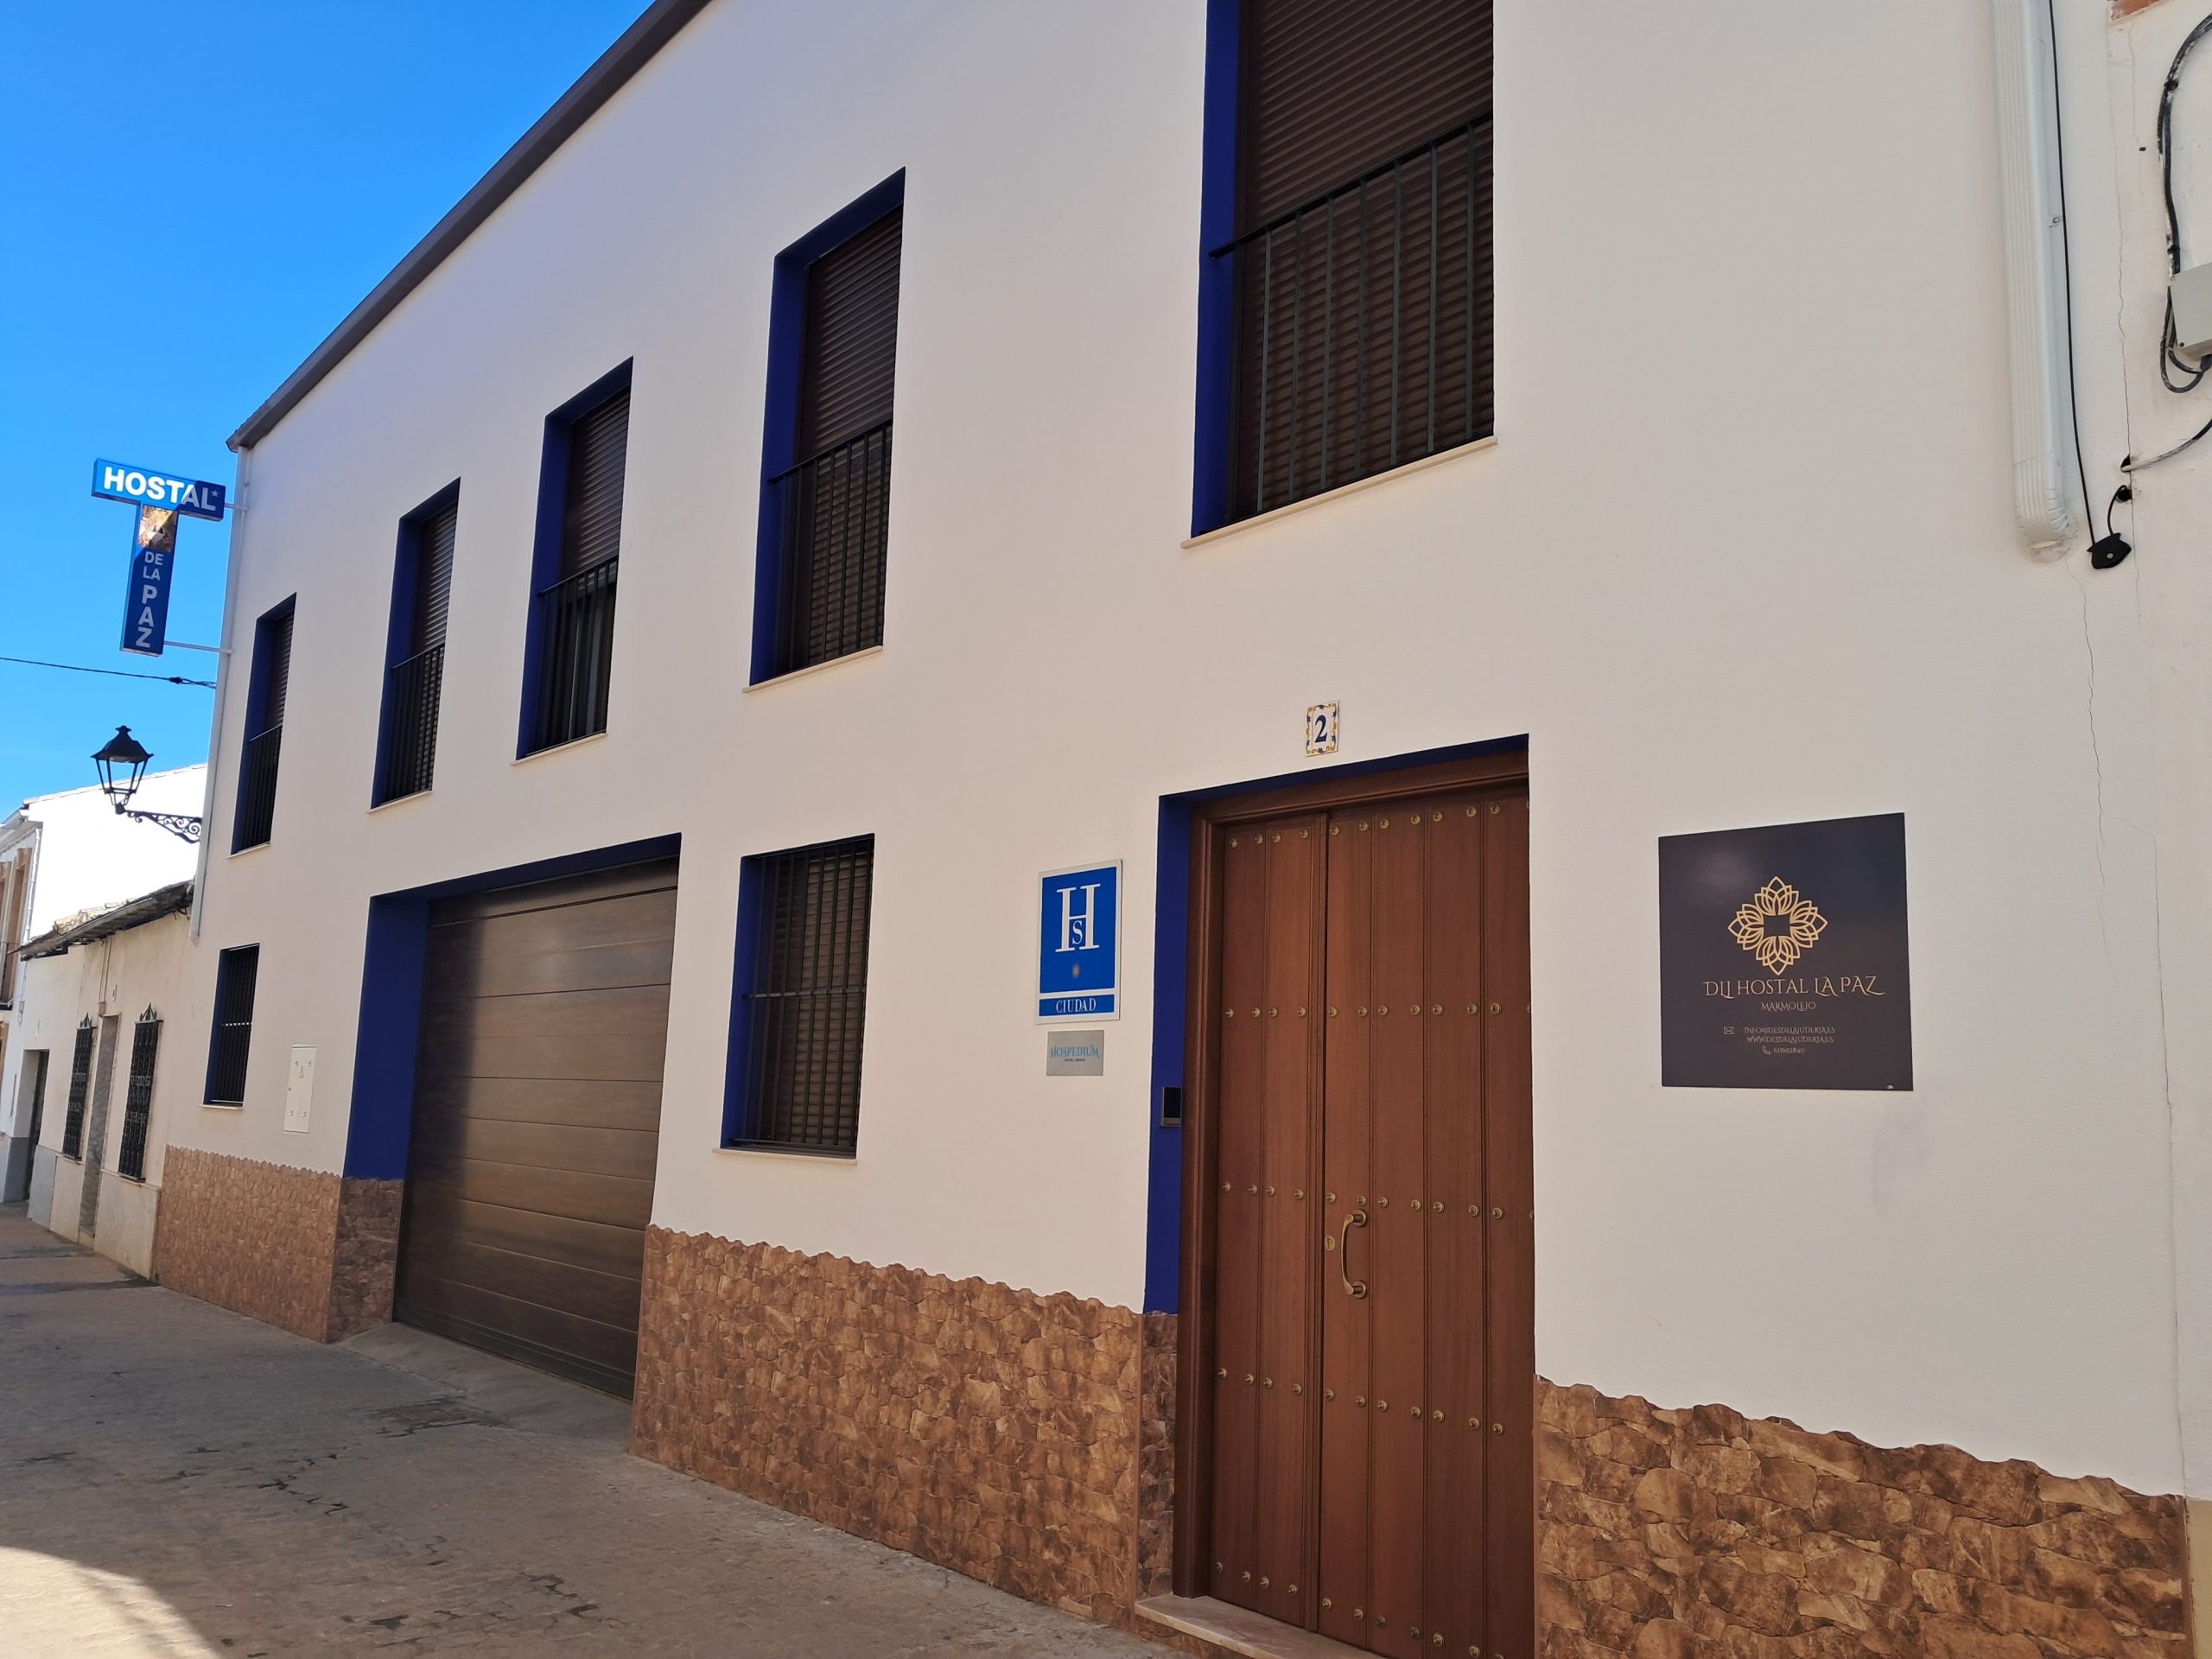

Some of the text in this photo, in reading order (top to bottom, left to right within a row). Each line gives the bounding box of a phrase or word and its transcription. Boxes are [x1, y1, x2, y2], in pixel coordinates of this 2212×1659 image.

[104, 467, 216, 512] HOSTAL
[144, 550, 164, 566] DE
[143, 565, 161, 582] LA
[136, 584, 158, 648] PAZ
[1314, 715, 1328, 743] 2
[1738, 977, 1808, 995] HOSTAL
[1814, 976, 1840, 997] LA
[1840, 975, 1886, 996] PAZ
[1055, 997, 1096, 1014] CIUDAD
[1760, 1001, 1816, 1012] MARMOLEJO
[1050, 1044, 1100, 1058] HOSPEDIUM
